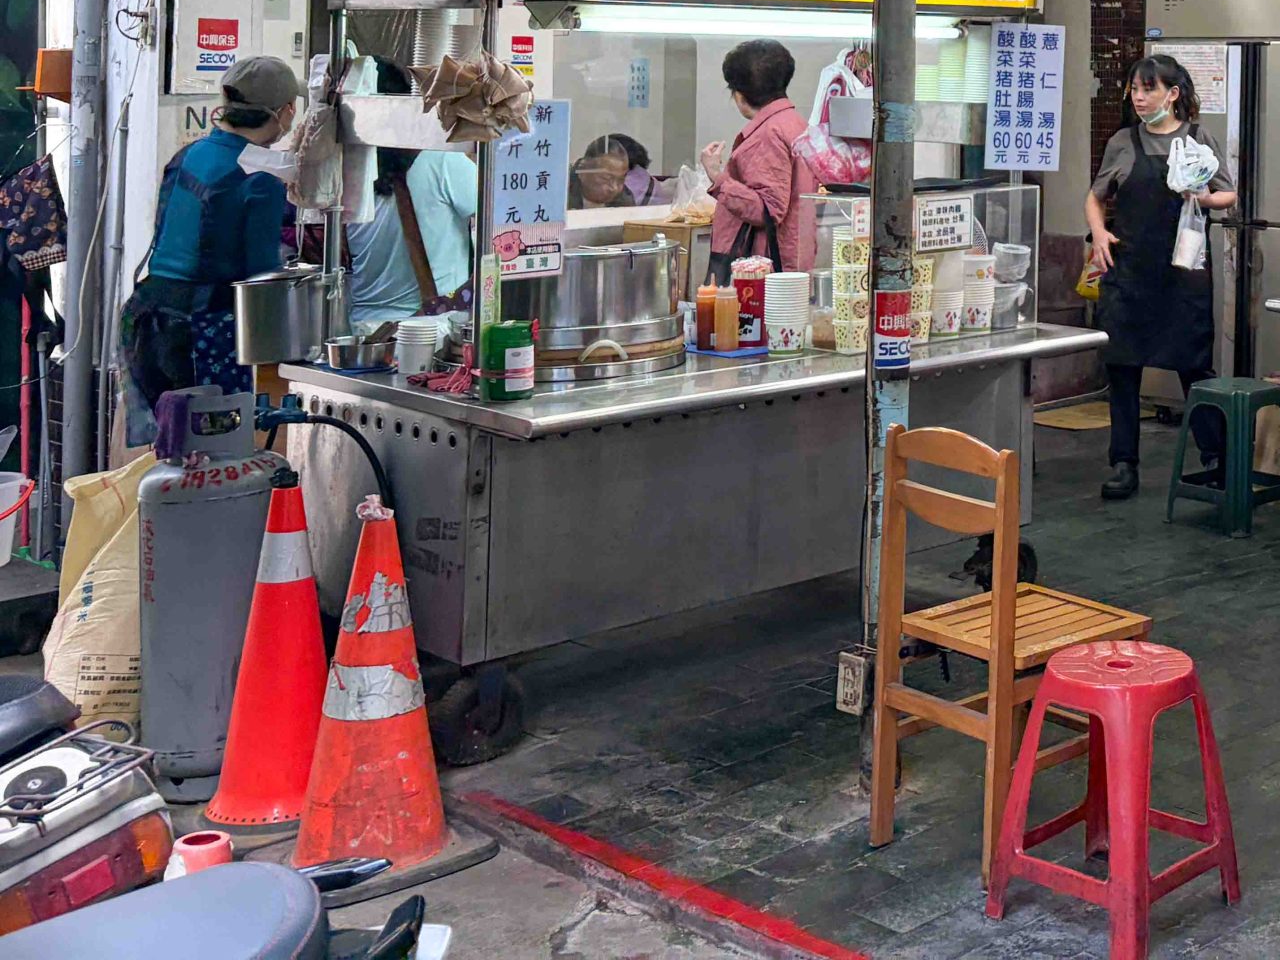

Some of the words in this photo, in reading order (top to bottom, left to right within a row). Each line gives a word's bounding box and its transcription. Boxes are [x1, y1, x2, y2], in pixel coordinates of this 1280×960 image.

[200, 34, 236, 47] 中興保全
[199, 53, 236, 64] SECOM
[533, 105, 554, 224] 新竹貢丸
